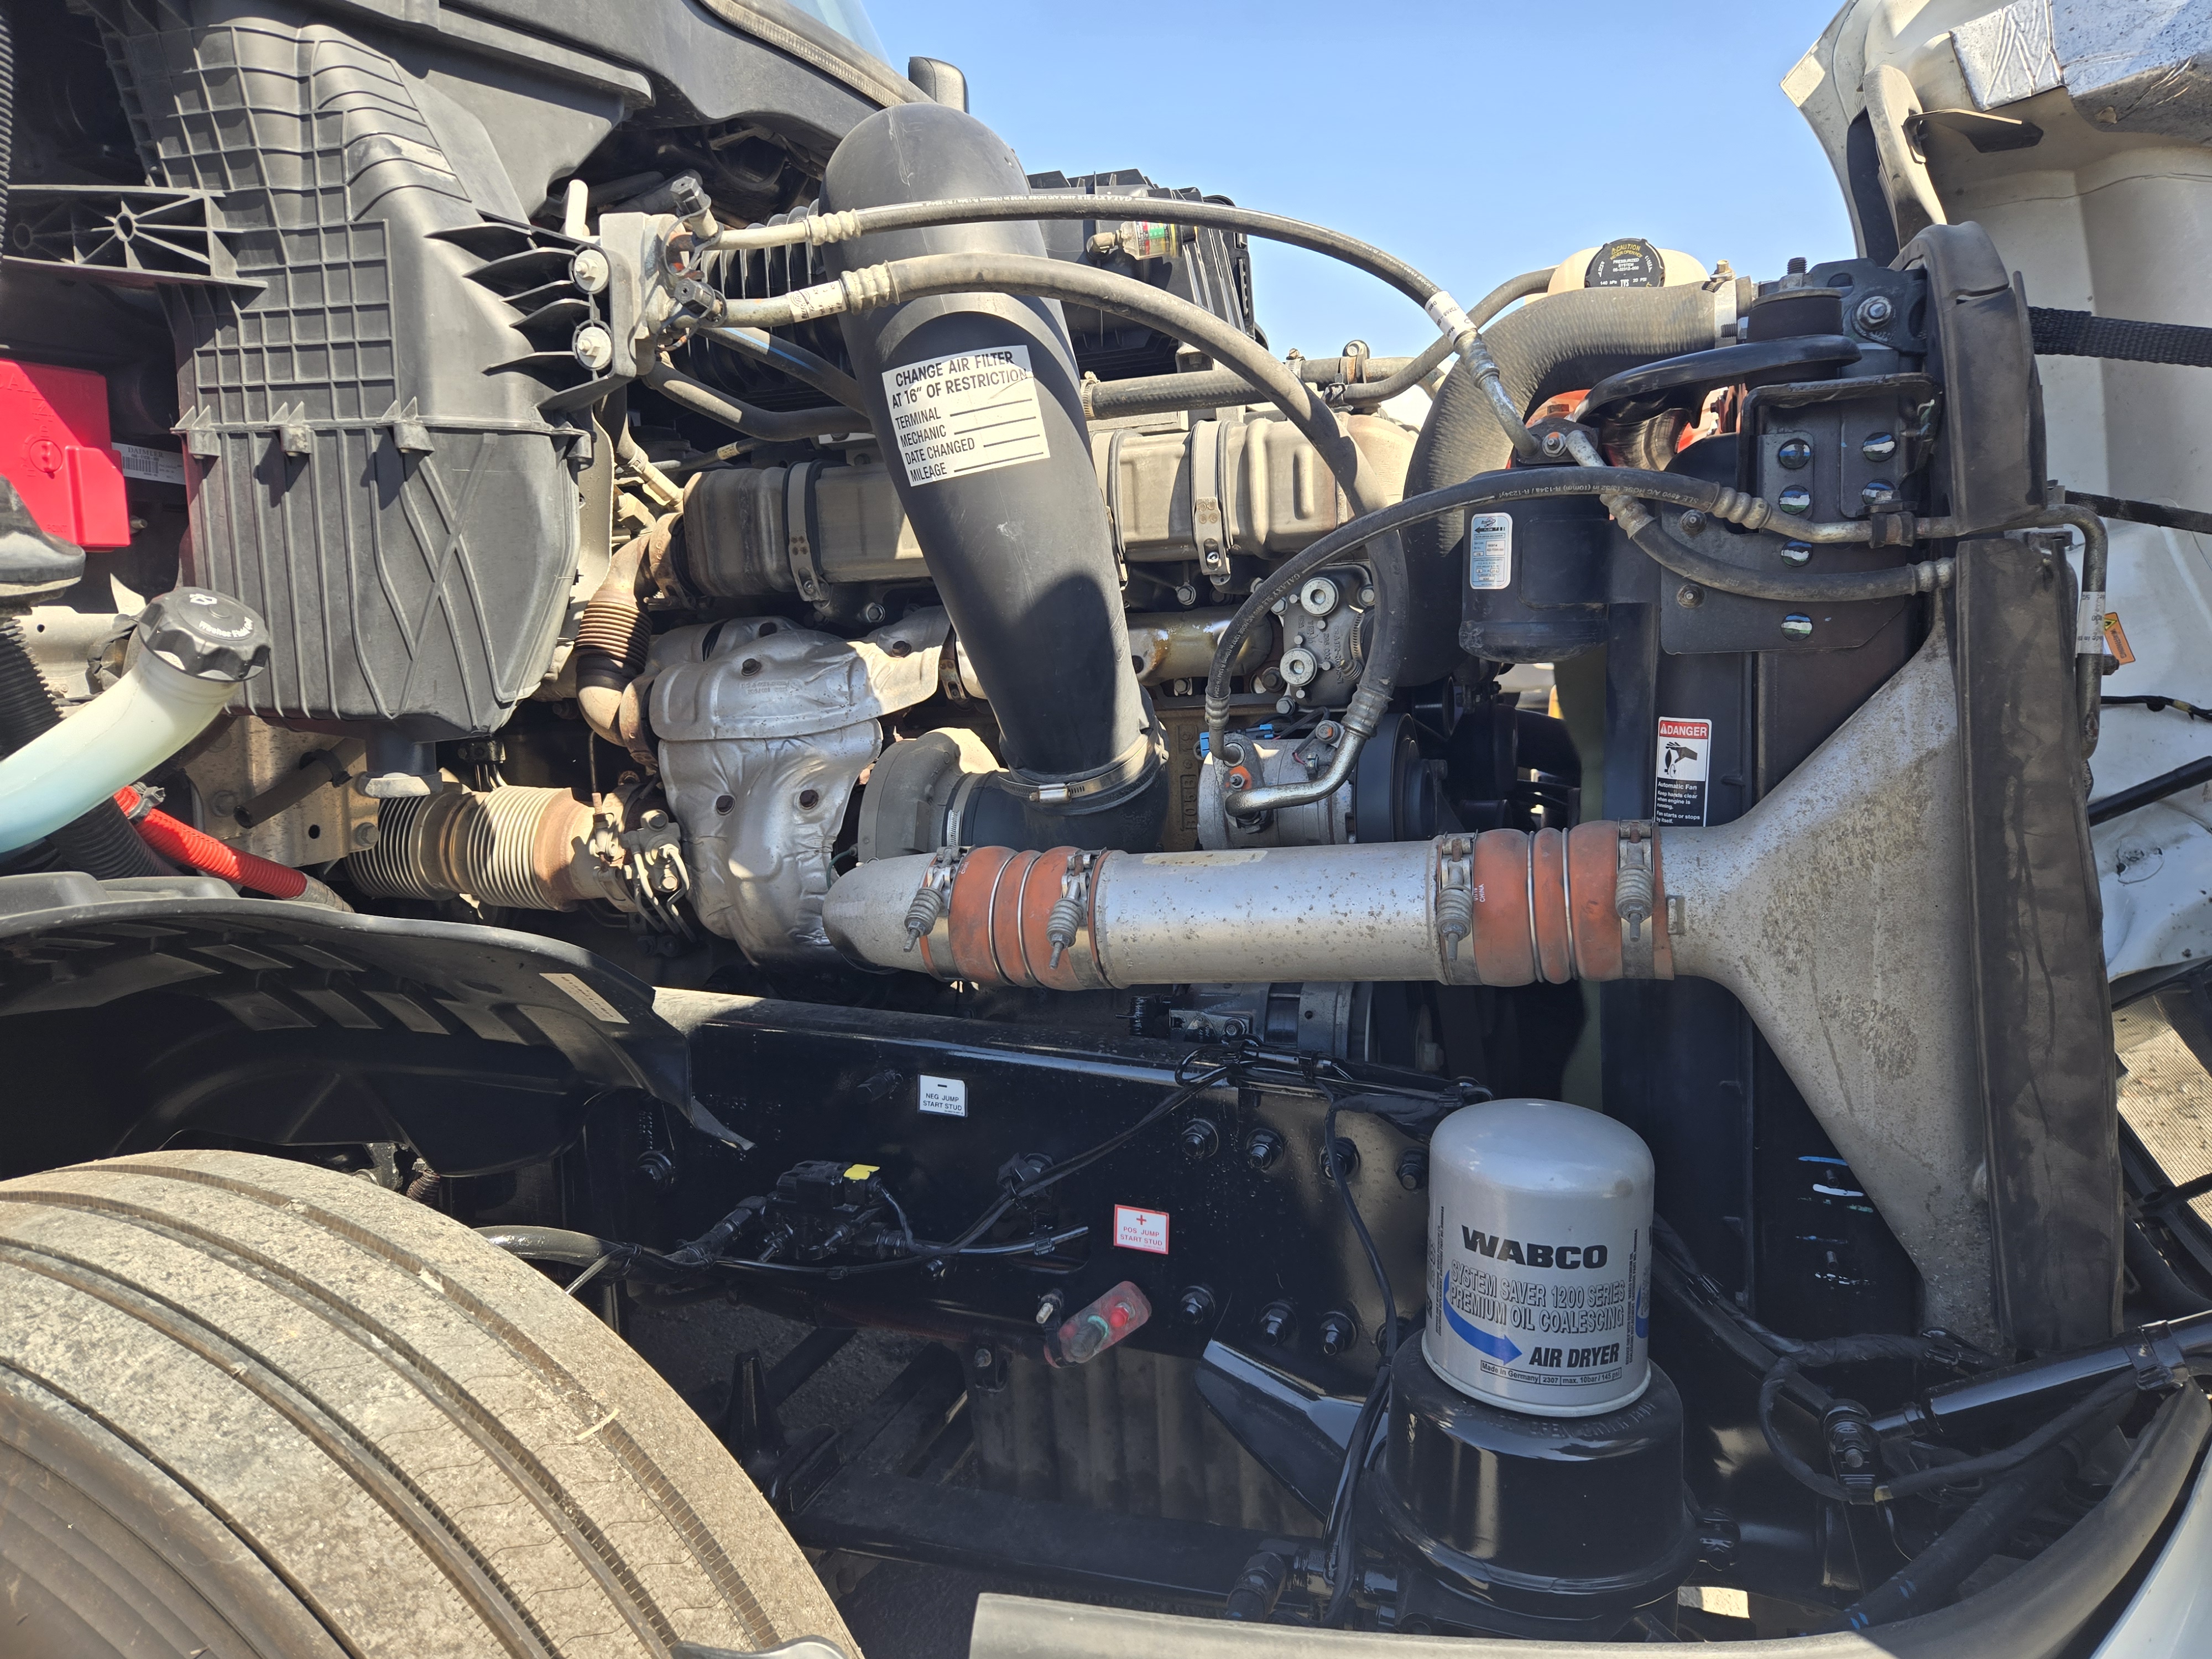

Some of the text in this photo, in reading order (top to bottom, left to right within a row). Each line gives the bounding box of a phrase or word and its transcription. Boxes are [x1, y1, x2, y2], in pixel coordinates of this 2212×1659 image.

[895, 351, 1013, 387] CHANGE AIR FILTER
[892, 392, 903, 409] AT
[926, 384, 942, 398] OF
[945, 368, 1027, 394] RESTRICTION
[895, 407, 941, 430] TERMINAL
[900, 424, 947, 448] MECHANIC
[128, 447, 164, 458] DAIMLER
[905, 437, 975, 465] DATE CHANGED
[910, 462, 947, 483] MILEAGE
[1536, 486, 1561, 494] R-134a
[1623, 486, 1645, 495] HOSE
[1682, 495, 1699, 504] SLE
[1272, 573, 1301, 598] GALAXY
[1261, 595, 1274, 606] SLE
[199, 620, 232, 637] Washer
[232, 626, 251, 638] Fluid
[1238, 620, 1250, 634] HOSE
[1667, 726, 1707, 737] DANGER
[1658, 781, 1684, 790] Automatic
[923, 1100, 943, 1108] START
[1120, 1234, 1162, 1246] START STUD
[1461, 1224, 1608, 1270] WABCO
[1451, 1259, 1498, 1298] SYSTEM
[1500, 1277, 1546, 1308] SAVER
[1551, 1285, 1585, 1308] 1200
[1587, 1280, 1625, 1307] SERIES
[1450, 1282, 1625, 1334] PREMIUM OIL COALESCING
[1529, 1342, 1620, 1368] AIR DRYER
[1482, 1362, 1539, 1383] Made in Germany
[1601, 1373, 1611, 1381] 145
[1612, 1370, 1620, 1380] psi
